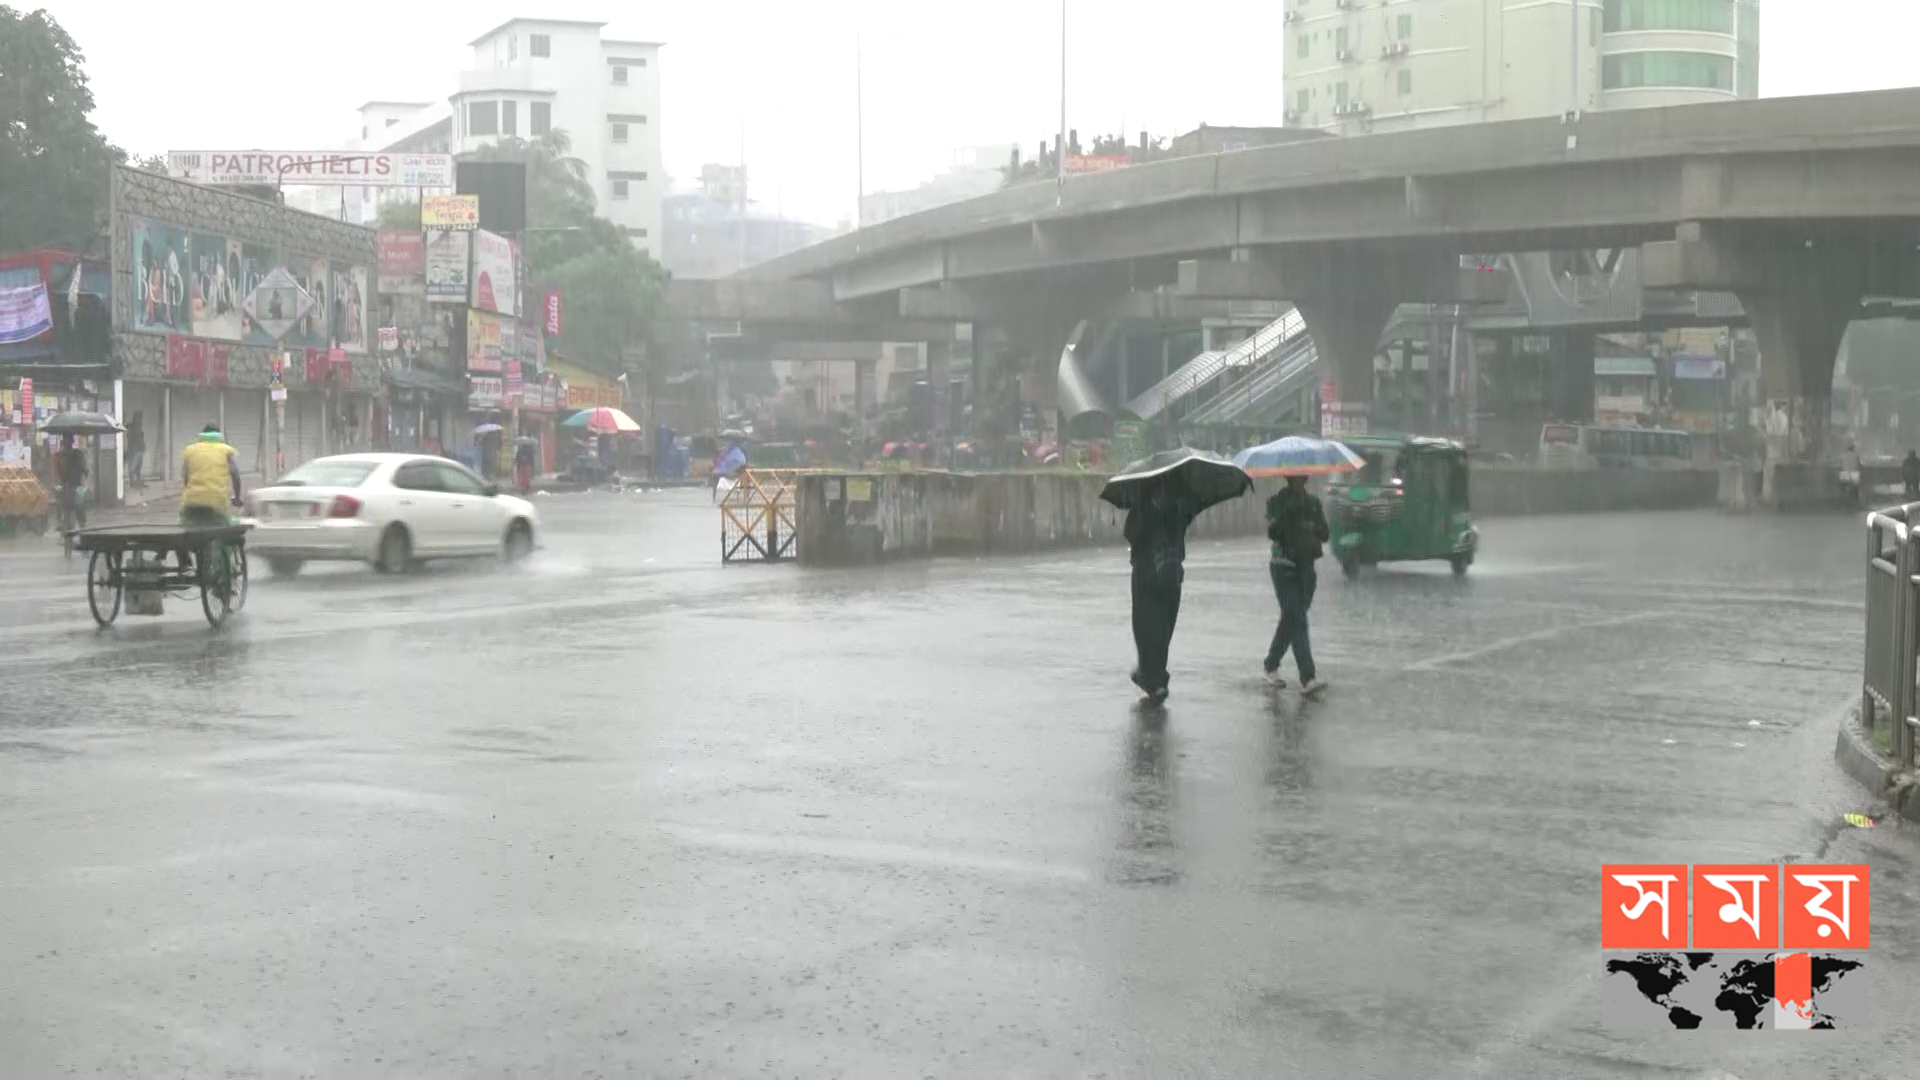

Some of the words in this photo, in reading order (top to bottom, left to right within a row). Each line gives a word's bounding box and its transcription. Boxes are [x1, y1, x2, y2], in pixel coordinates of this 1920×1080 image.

[212, 154, 312, 174] PATRON
[322, 155, 390, 175] IELTS
[547, 295, 559, 335] Bata
